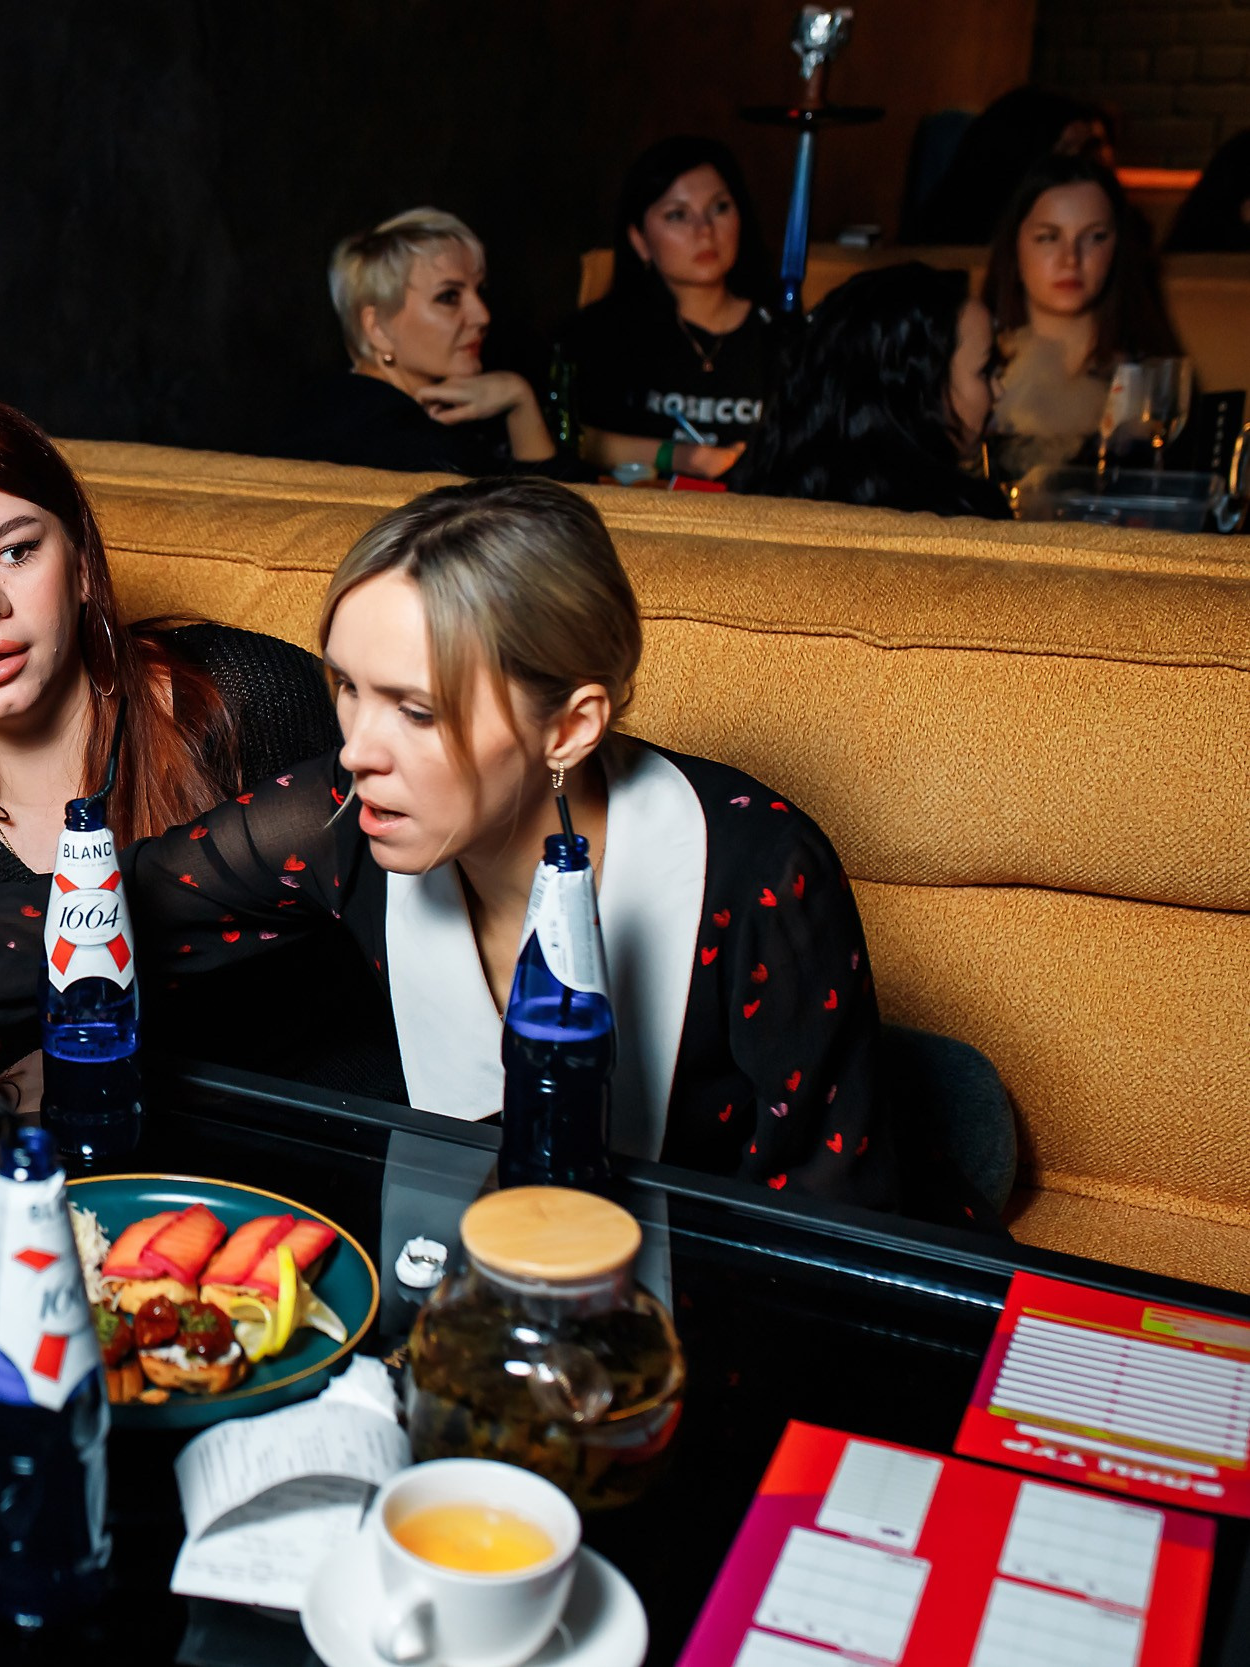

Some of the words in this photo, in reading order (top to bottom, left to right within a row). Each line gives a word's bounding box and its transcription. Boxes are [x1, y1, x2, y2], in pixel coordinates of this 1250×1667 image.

[646, 389, 762, 424] ROSECC
[63, 841, 112, 859] BLANC
[59, 901, 122, 930] 1664
